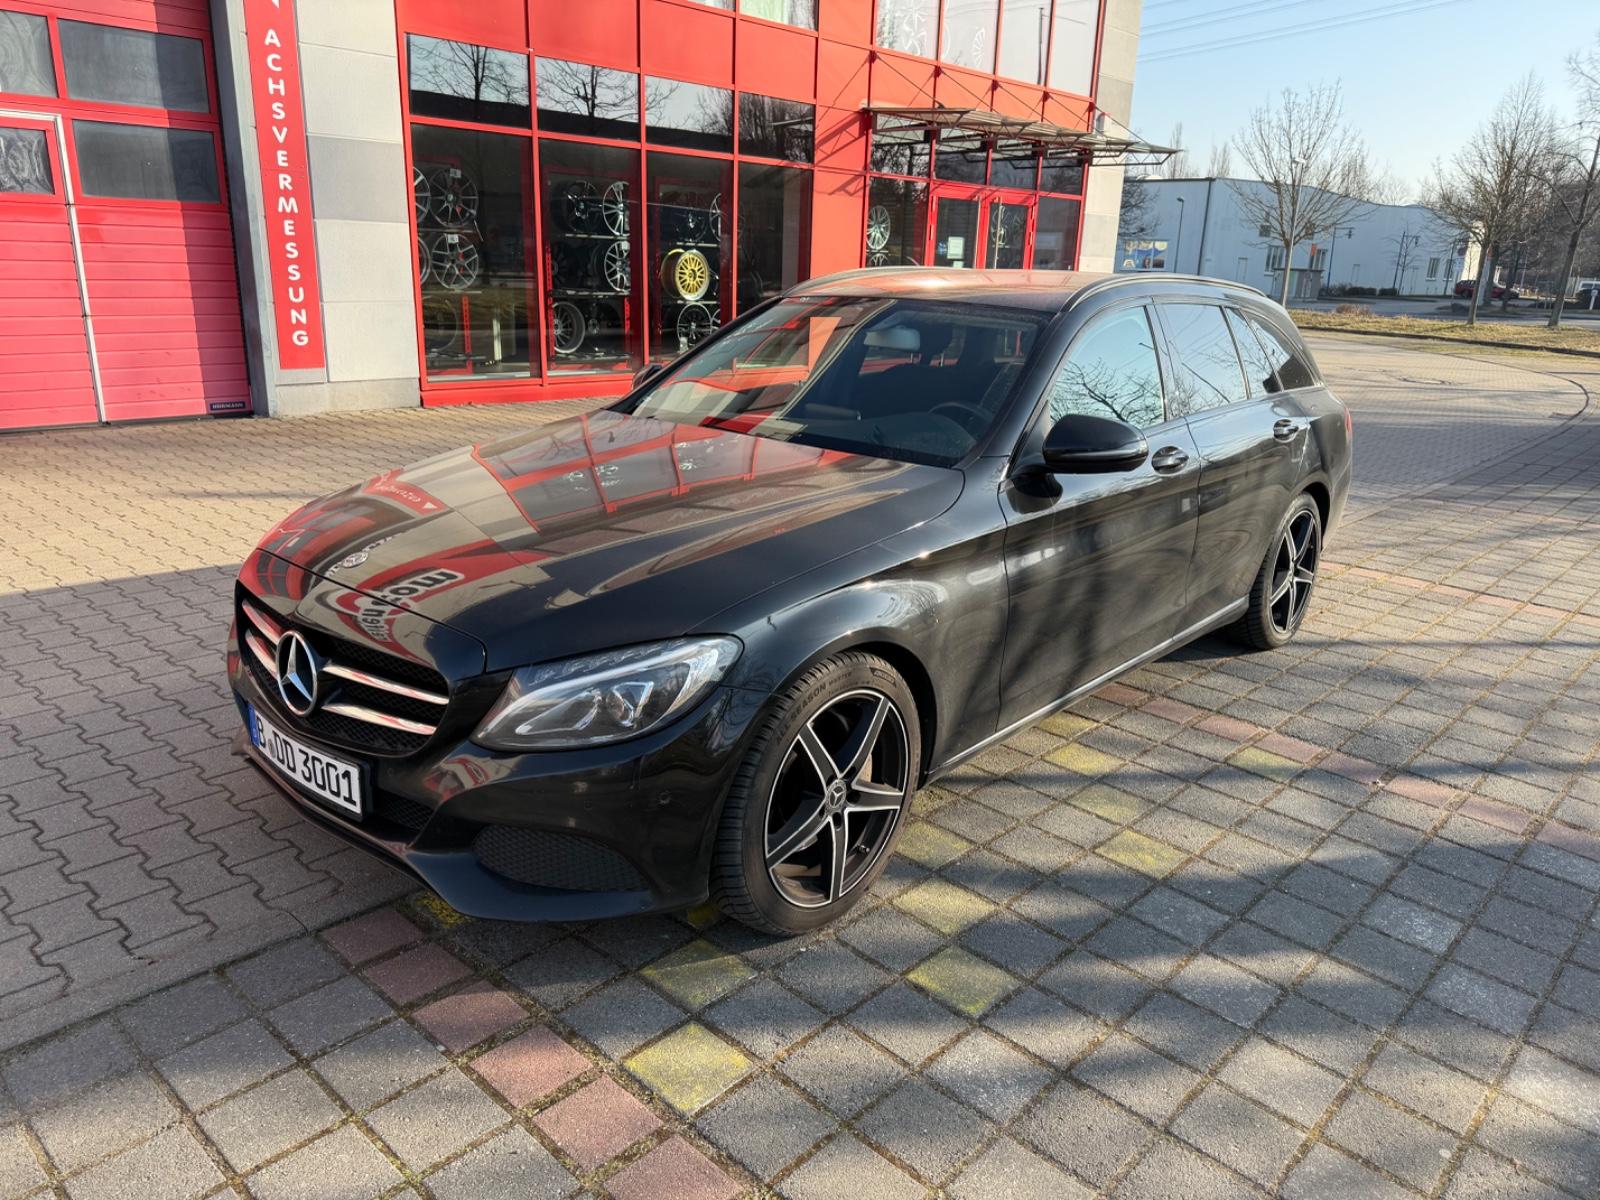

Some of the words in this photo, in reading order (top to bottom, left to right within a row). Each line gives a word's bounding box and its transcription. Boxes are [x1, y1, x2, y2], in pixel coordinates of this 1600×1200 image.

[264, 28, 309, 346] ACHSVERMESSUNG
[790, 682, 826, 720] SEASON
[256, 715, 266, 748] B
[272, 730, 296, 773] DD
[299, 748, 356, 806] 3001
